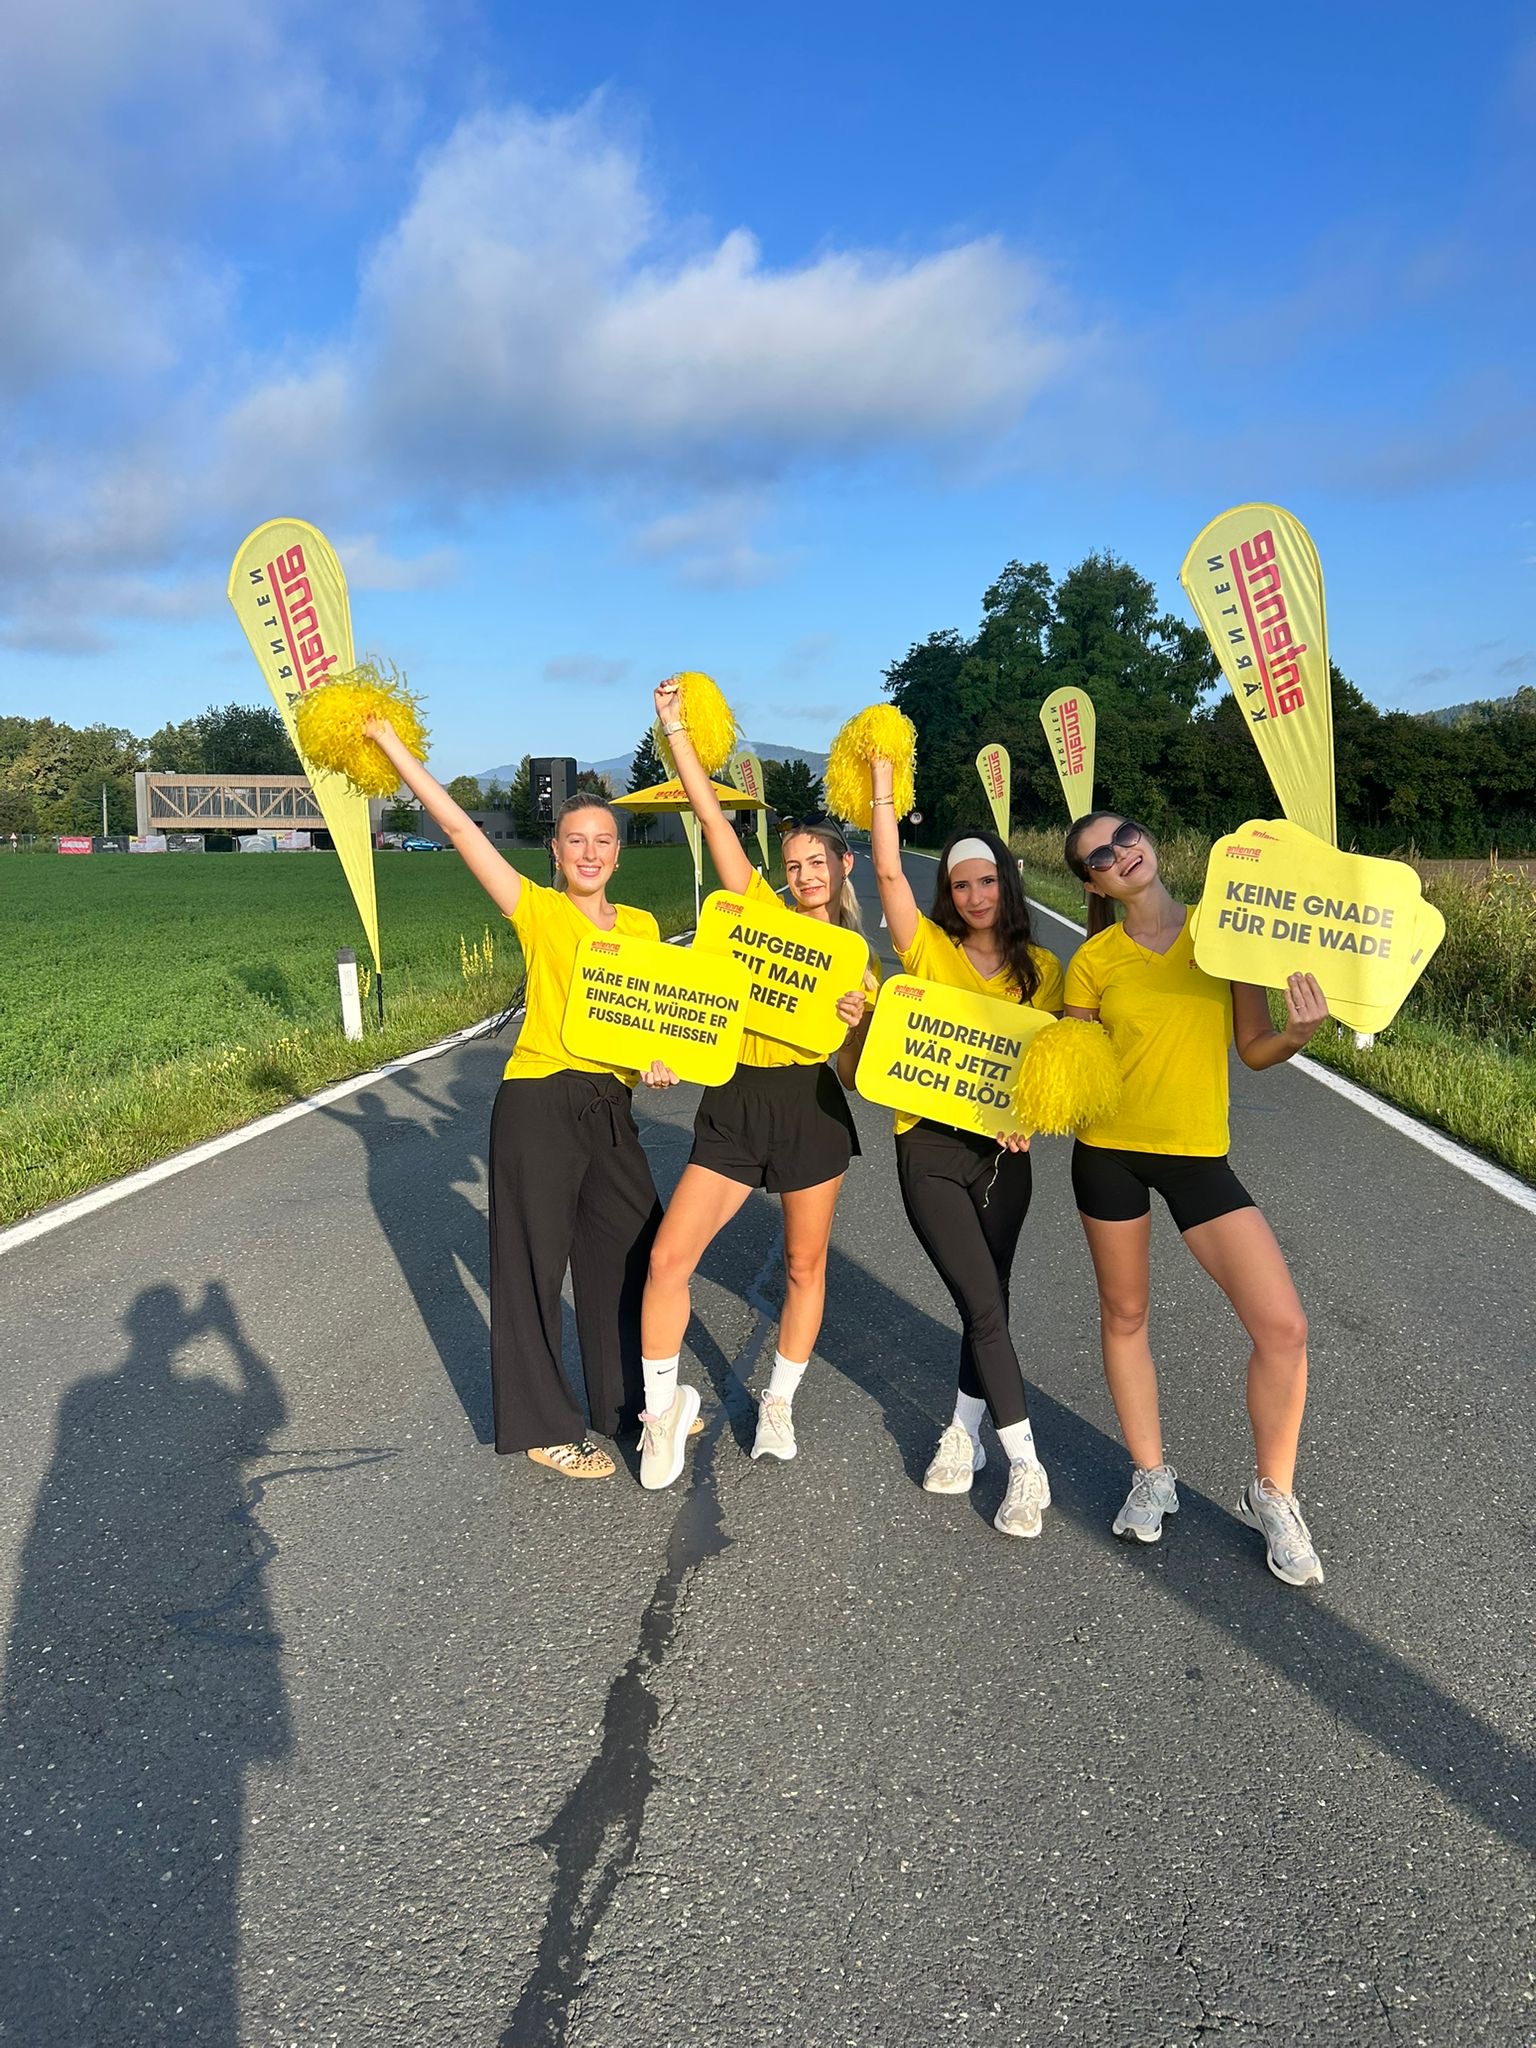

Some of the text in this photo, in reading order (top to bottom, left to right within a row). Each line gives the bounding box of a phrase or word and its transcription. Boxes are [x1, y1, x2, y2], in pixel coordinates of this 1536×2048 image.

[1226, 844, 1262, 856] antenne
[1226, 880, 1394, 929] KEINE GNADE
[728, 924, 832, 971] AUFGEBEN
[1218, 907, 1265, 936] FÜR
[1271, 919, 1312, 945] DIE
[1318, 927, 1392, 959] WADE
[582, 967, 739, 1012] WÄRE EIN MARATHON
[750, 983, 798, 1013] RIEFE
[768, 963, 817, 993] MAN
[586, 987, 728, 1029] EINFACH, WÜRDE ER
[588, 1007, 718, 1045] FUSSBALL HEISSEN
[907, 1012, 1022, 1058] UMDREHEN
[905, 1037, 1012, 1082] WÄR JETZT
[887, 1061, 1011, 1109] AUCH BLÖD
